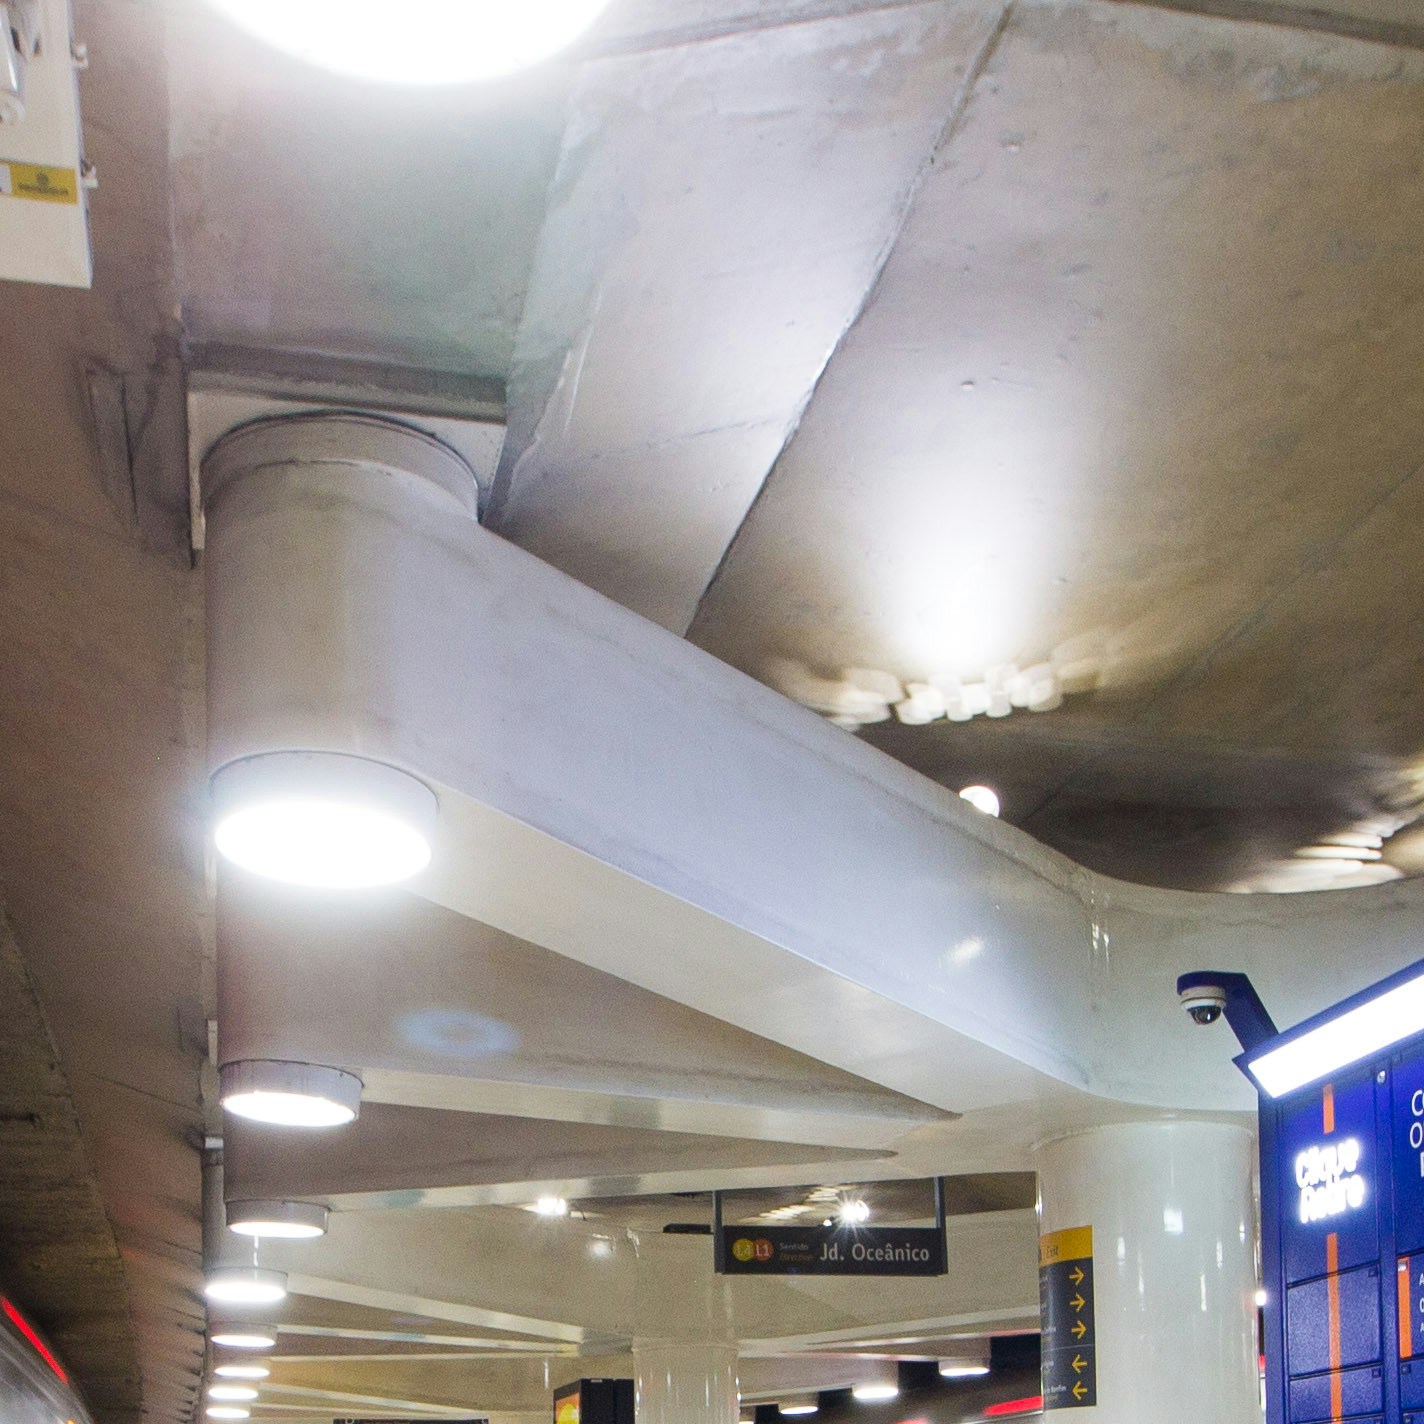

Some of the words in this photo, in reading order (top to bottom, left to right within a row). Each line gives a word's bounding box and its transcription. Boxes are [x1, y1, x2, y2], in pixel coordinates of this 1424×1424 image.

[755, 1243, 770, 1257] L1
[820, 1243, 845, 1261] Jd.
[852, 1243, 930, 1261] Oceânico
